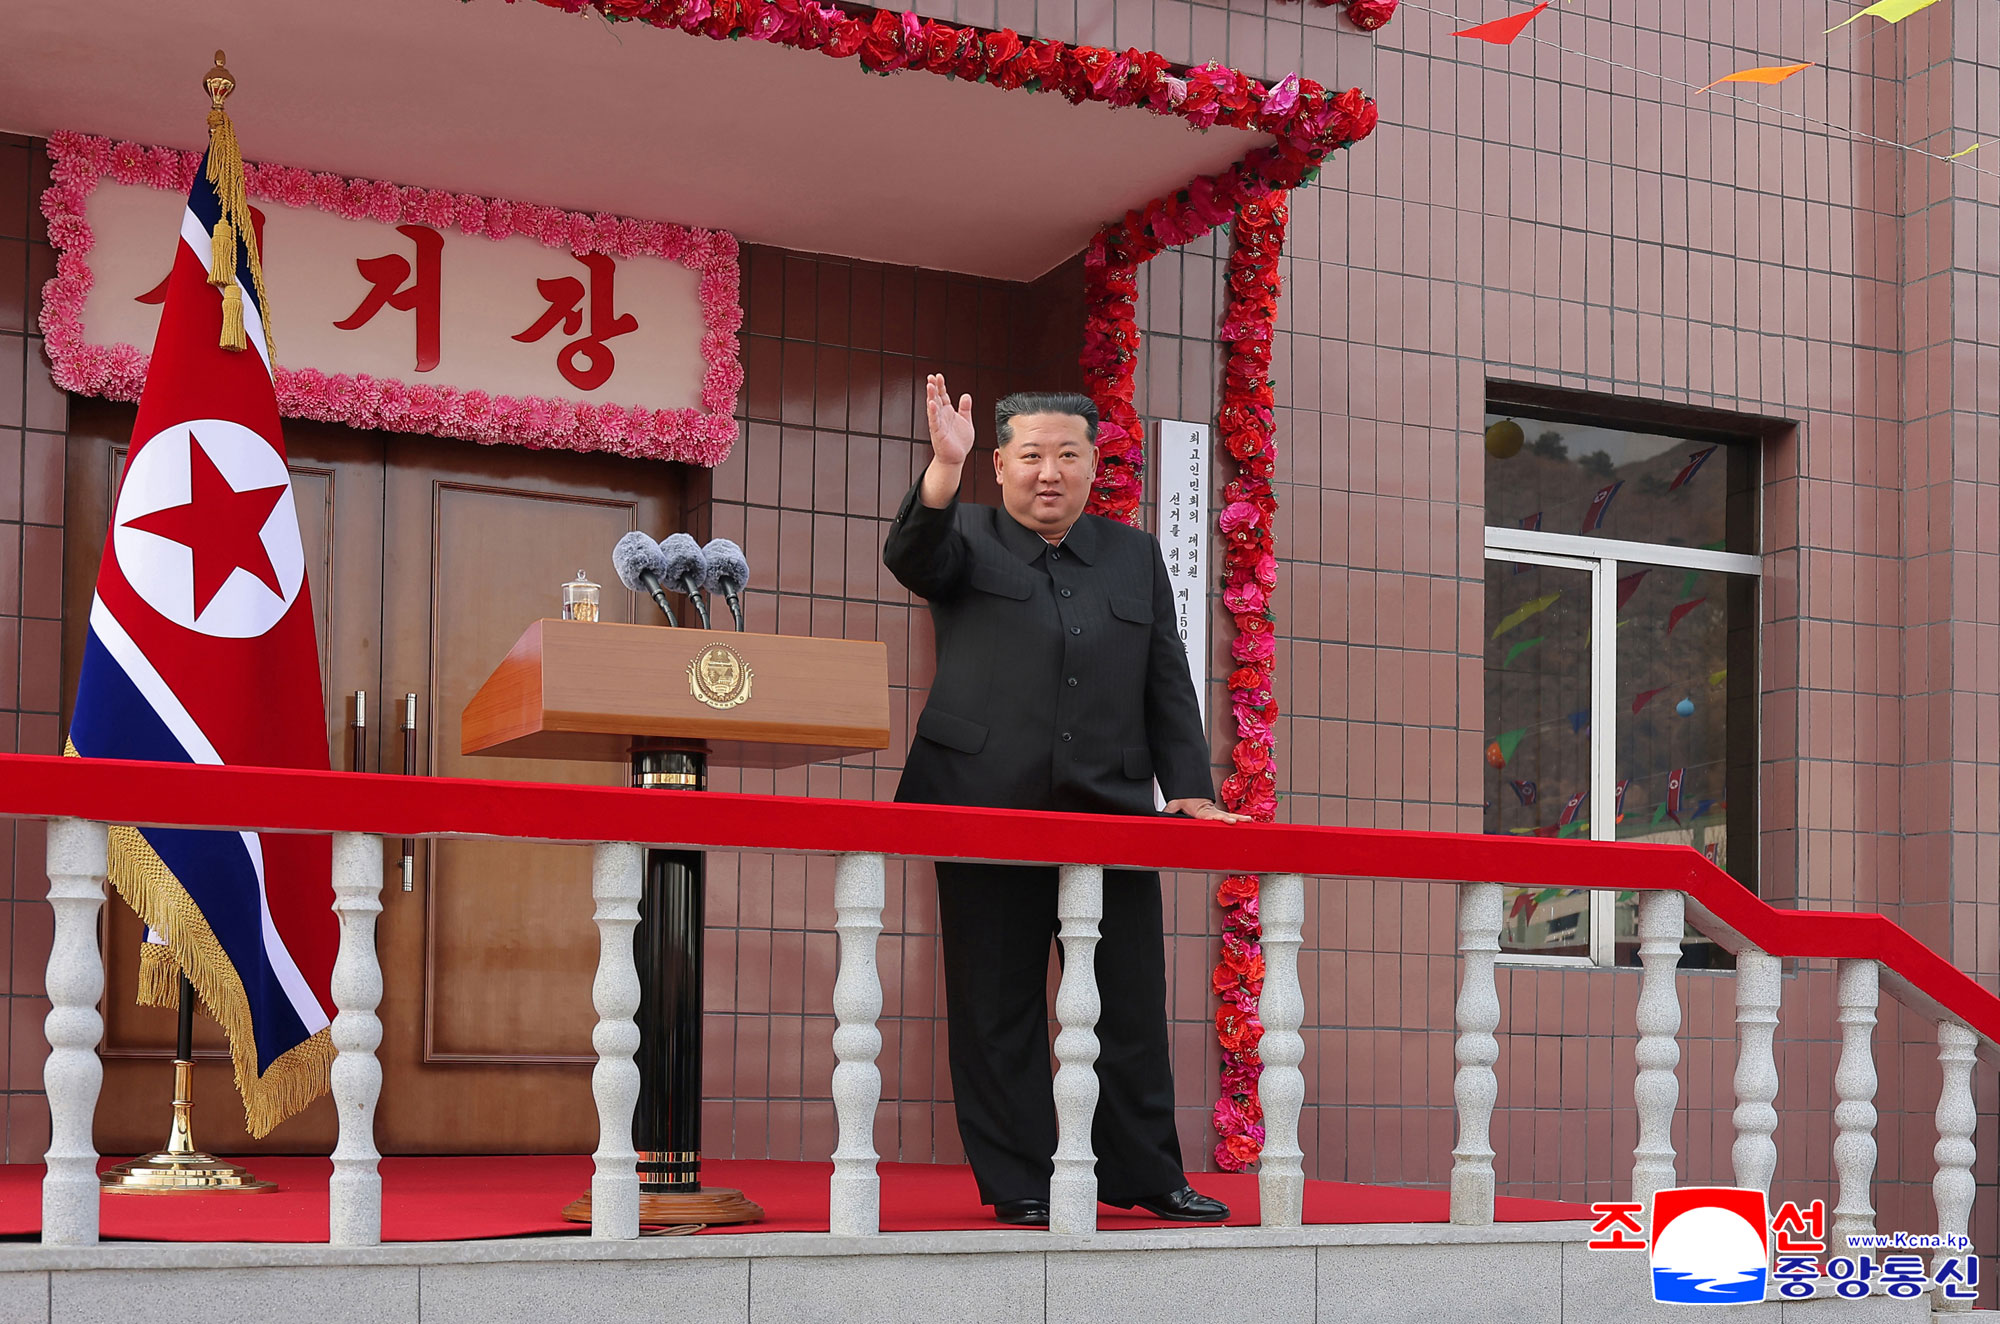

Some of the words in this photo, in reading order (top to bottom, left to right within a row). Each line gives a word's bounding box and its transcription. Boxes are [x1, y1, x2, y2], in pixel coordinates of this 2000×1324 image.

[135, 205, 638, 390] 거장
[1189, 430, 1200, 523] 최고인민회의
[1169, 492, 1181, 538] 선거를
[1169, 547, 1181, 577] 위한
[1187, 533, 1199, 578] 대의원
